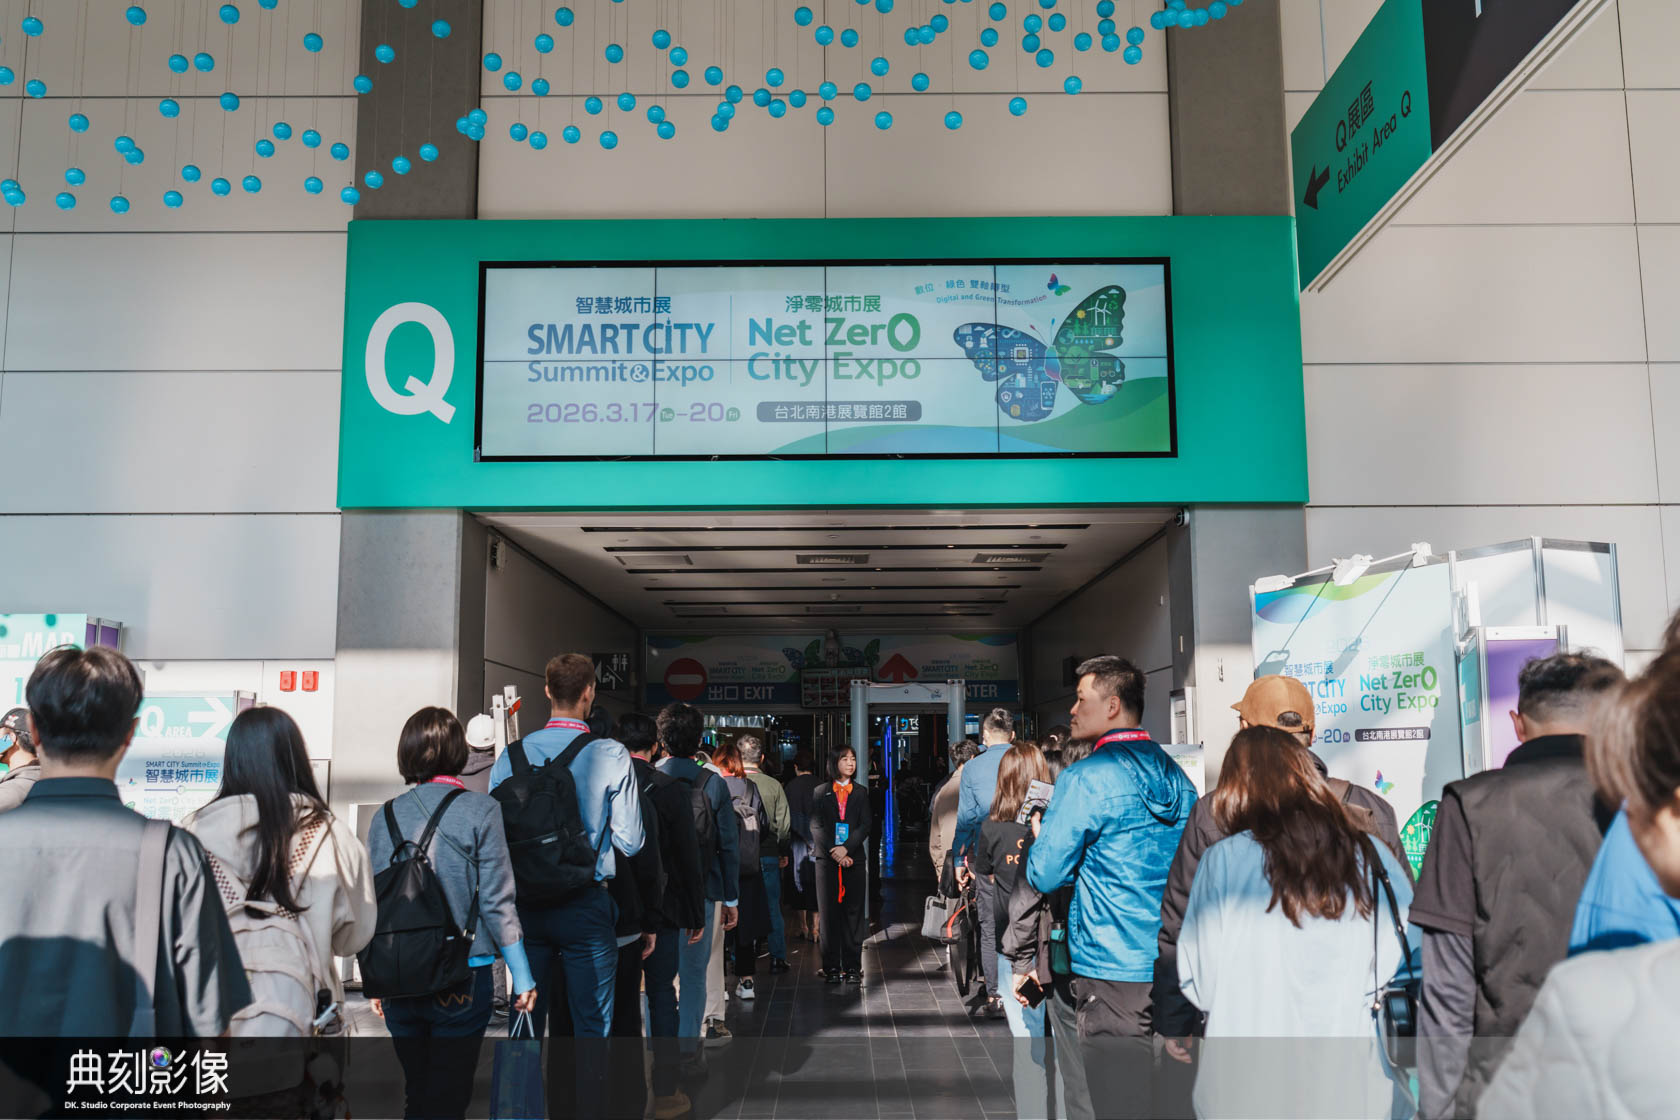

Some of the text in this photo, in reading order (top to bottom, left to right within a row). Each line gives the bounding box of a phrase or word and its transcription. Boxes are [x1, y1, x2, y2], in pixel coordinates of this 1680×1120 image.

[1336, 80, 1374, 152] Q展區
[1338, 90, 1411, 194] Exhibit Area Q
[576, 296, 672, 314] 智慧城市展
[785, 295, 881, 313] 淨零城市展
[936, 294, 959, 304] Digital
[975, 294, 994, 303] Green
[997, 295, 1047, 306] Transformation
[748, 317, 813, 346] Net
[365, 301, 456, 425] Q
[747, 351, 921, 387] City Expo
[774, 404, 907, 420] 台北南港展覽館2館
[964, 684, 998, 698] NTER
[1359, 674, 1388, 691] Net
[708, 686, 738, 701] 出口
[744, 686, 775, 700] EXIT
[1360, 694, 1391, 714] City
[1397, 692, 1439, 712] Expo
[140, 705, 193, 737] Q AREA
[146, 769, 219, 784] 智慧城市展
